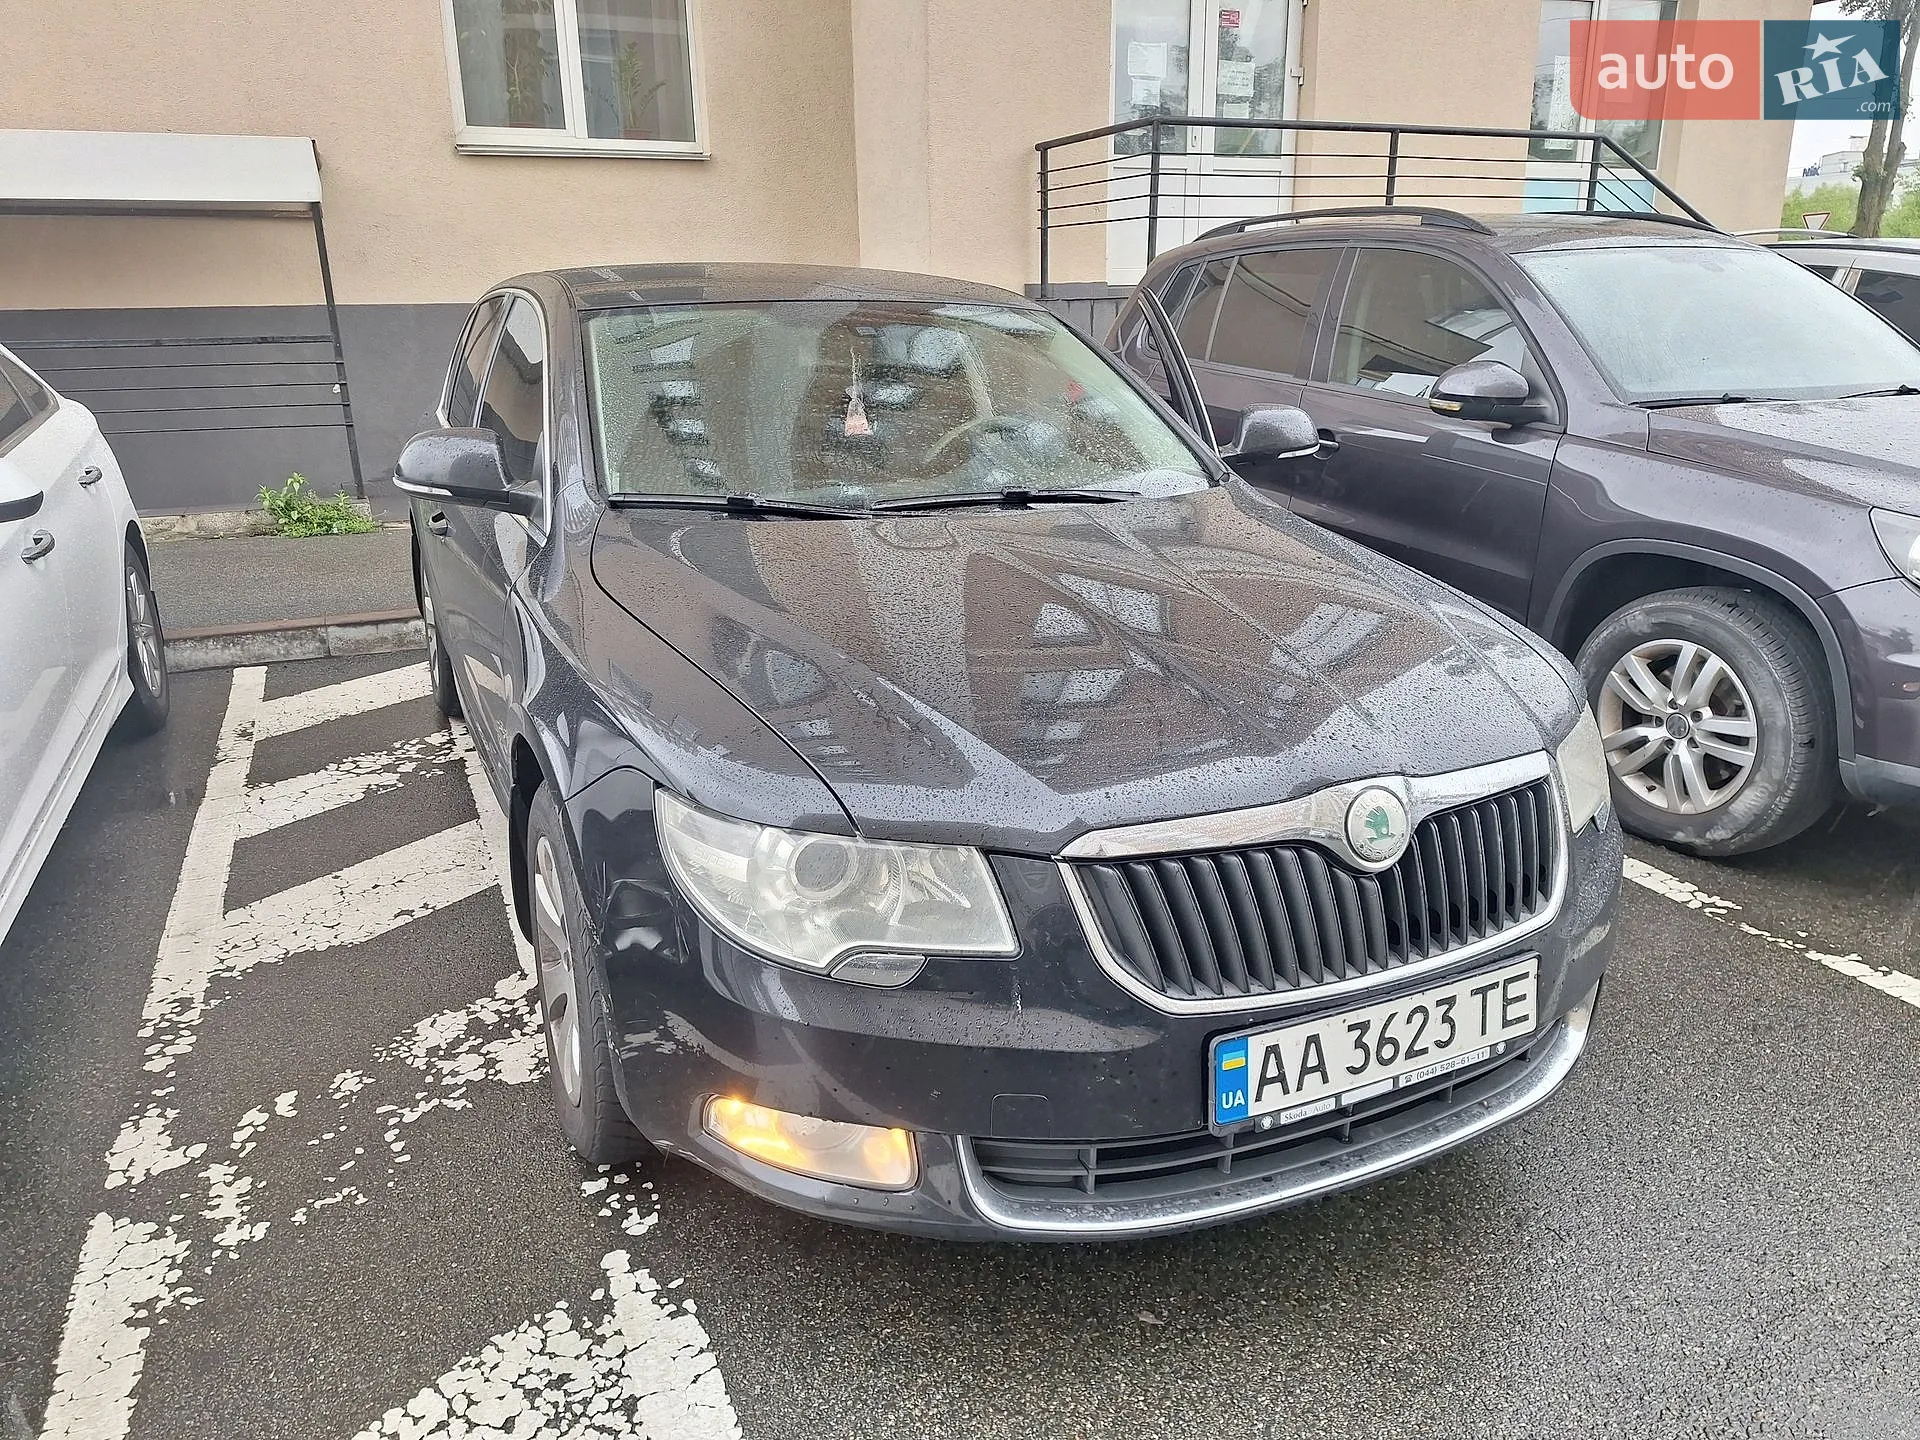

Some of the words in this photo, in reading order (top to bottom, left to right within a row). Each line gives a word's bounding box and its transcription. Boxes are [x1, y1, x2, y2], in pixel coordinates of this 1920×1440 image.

[1254, 1033, 1330, 1103] AA
[1345, 996, 1457, 1075] 3623
[1471, 971, 1530, 1036] TE
[1416, 1067, 1437, 1081] (044)
[1440, 1051, 1485, 1072] 528-61-11
[1222, 1088, 1246, 1109] UA
